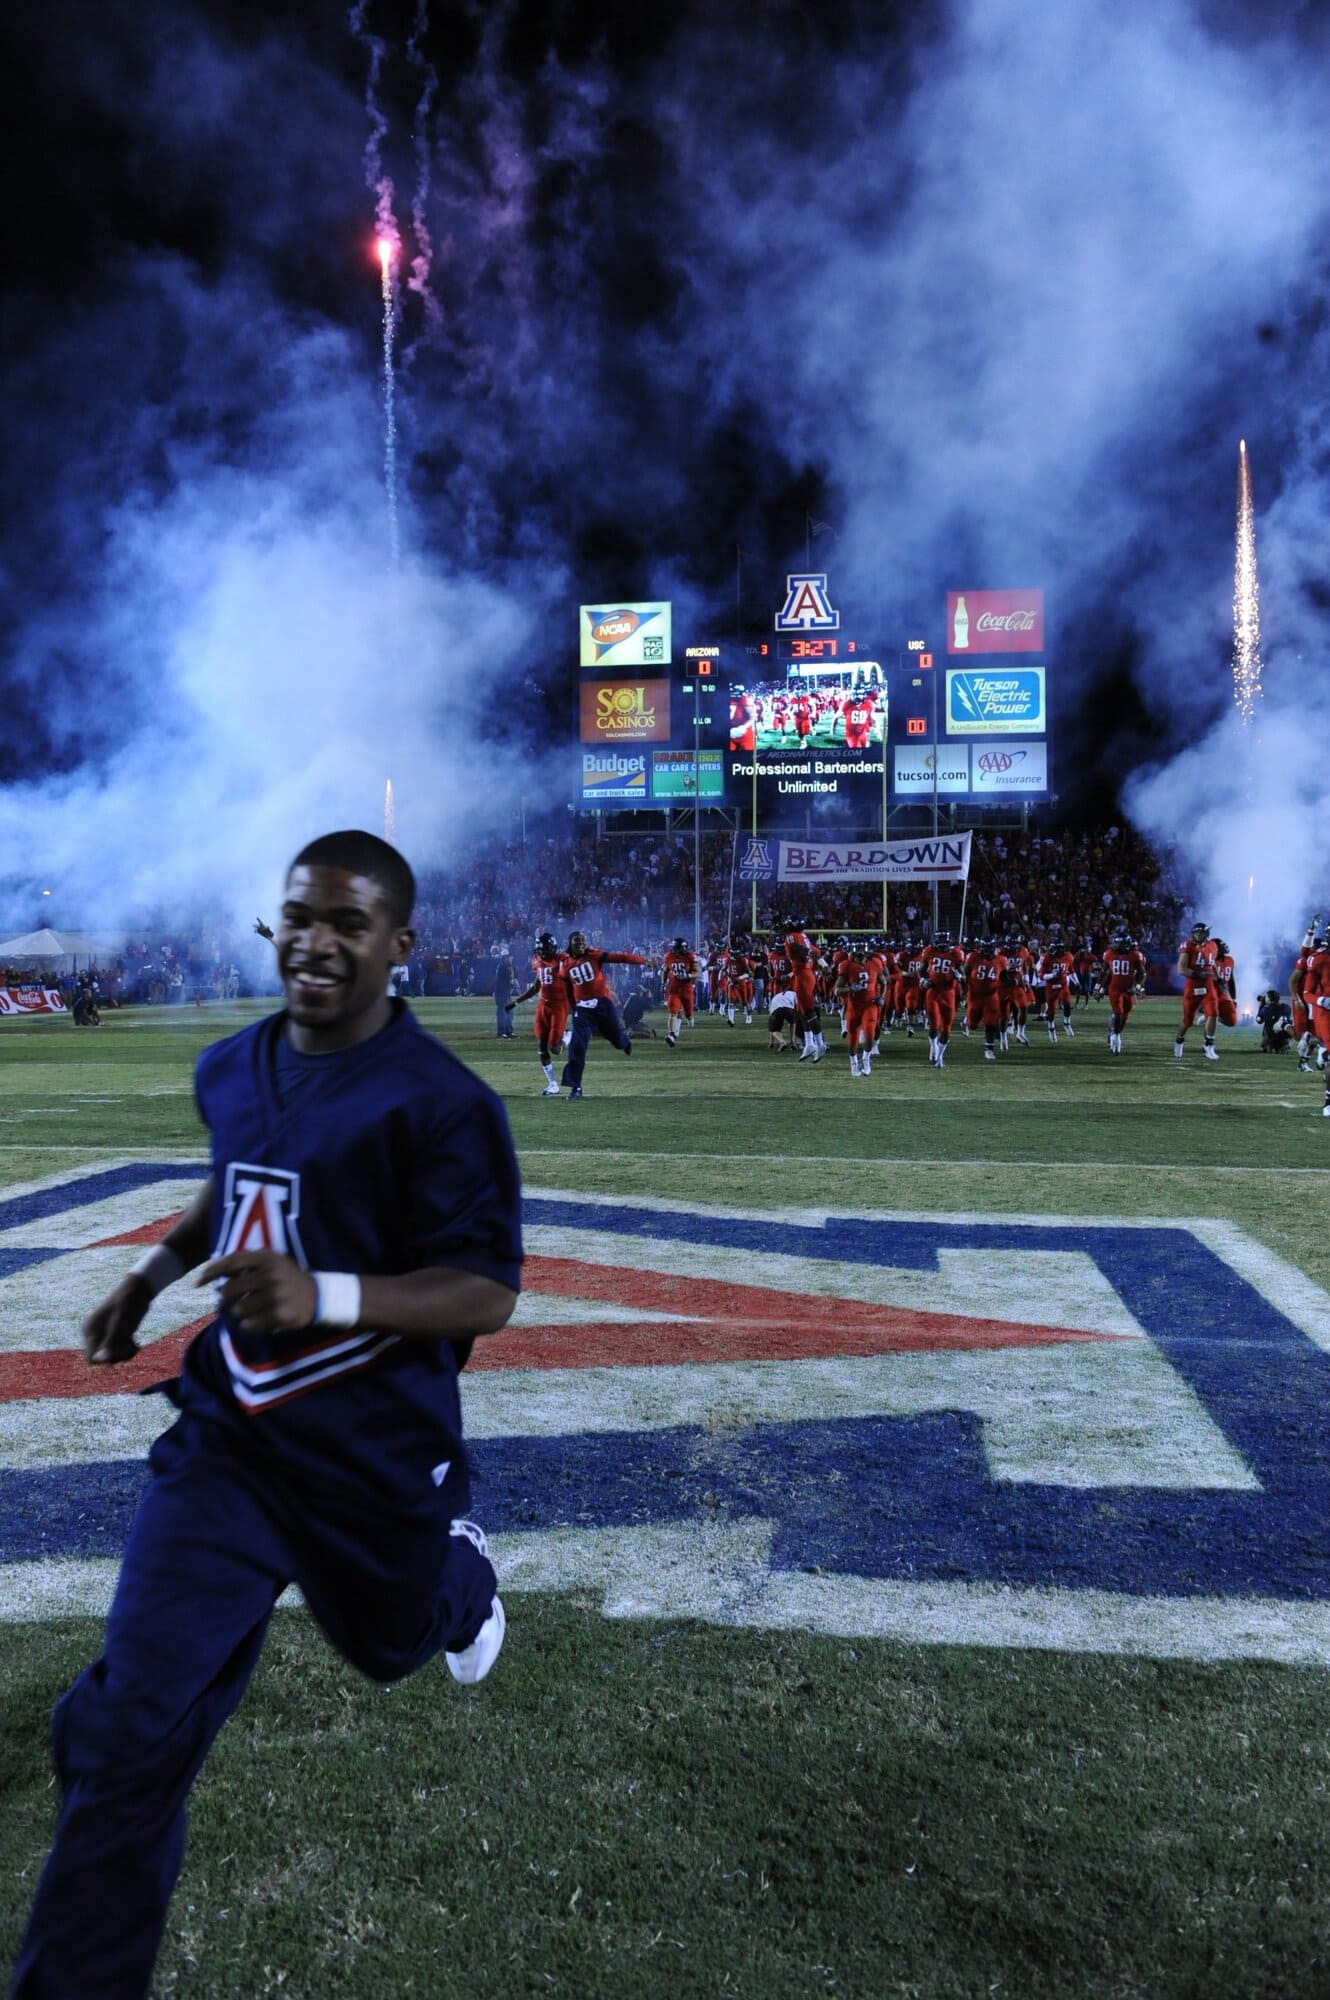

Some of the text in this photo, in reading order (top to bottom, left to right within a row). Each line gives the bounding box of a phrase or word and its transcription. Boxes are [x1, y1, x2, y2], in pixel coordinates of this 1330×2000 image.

[775, 573, 840, 631] A
[976, 610, 1038, 631] Coca-Cola
[599, 622, 631, 636] NCAA
[685, 647, 719, 656] ARIZONA
[760, 644, 768, 655] 3
[791, 640, 837, 657] 3:27
[848, 642, 856, 652] 3
[908, 640, 925, 650] USC
[699, 661, 711, 674] 0
[919, 654, 932, 668] 0
[973, 678, 1019, 691] Tucson
[596, 687, 655, 716] SOL
[977, 690, 1032, 702] Electric
[983, 702, 1032, 714] Power
[596, 715, 656, 729] CASINOS
[908, 719, 926, 734] 00
[583, 754, 645, 776] Budget
[655, 762, 721, 772] CAR CARE CNTERS
[732, 762, 810, 775] Professional
[815, 761, 885, 774] Bartenders
[981, 753, 1009, 771] AAA
[996, 774, 1042, 784] Insurance
[778, 780, 837, 793] Unlimited
[740, 839, 773, 869] A
[739, 870, 772, 880] CLUB
[933, 957, 951, 974] 26
[1196, 952, 1216, 967] 44
[569, 961, 595, 986] 90
[977, 965, 996, 980] 54
[1112, 959, 1130, 975] 80
[858, 972, 870, 990] 2
